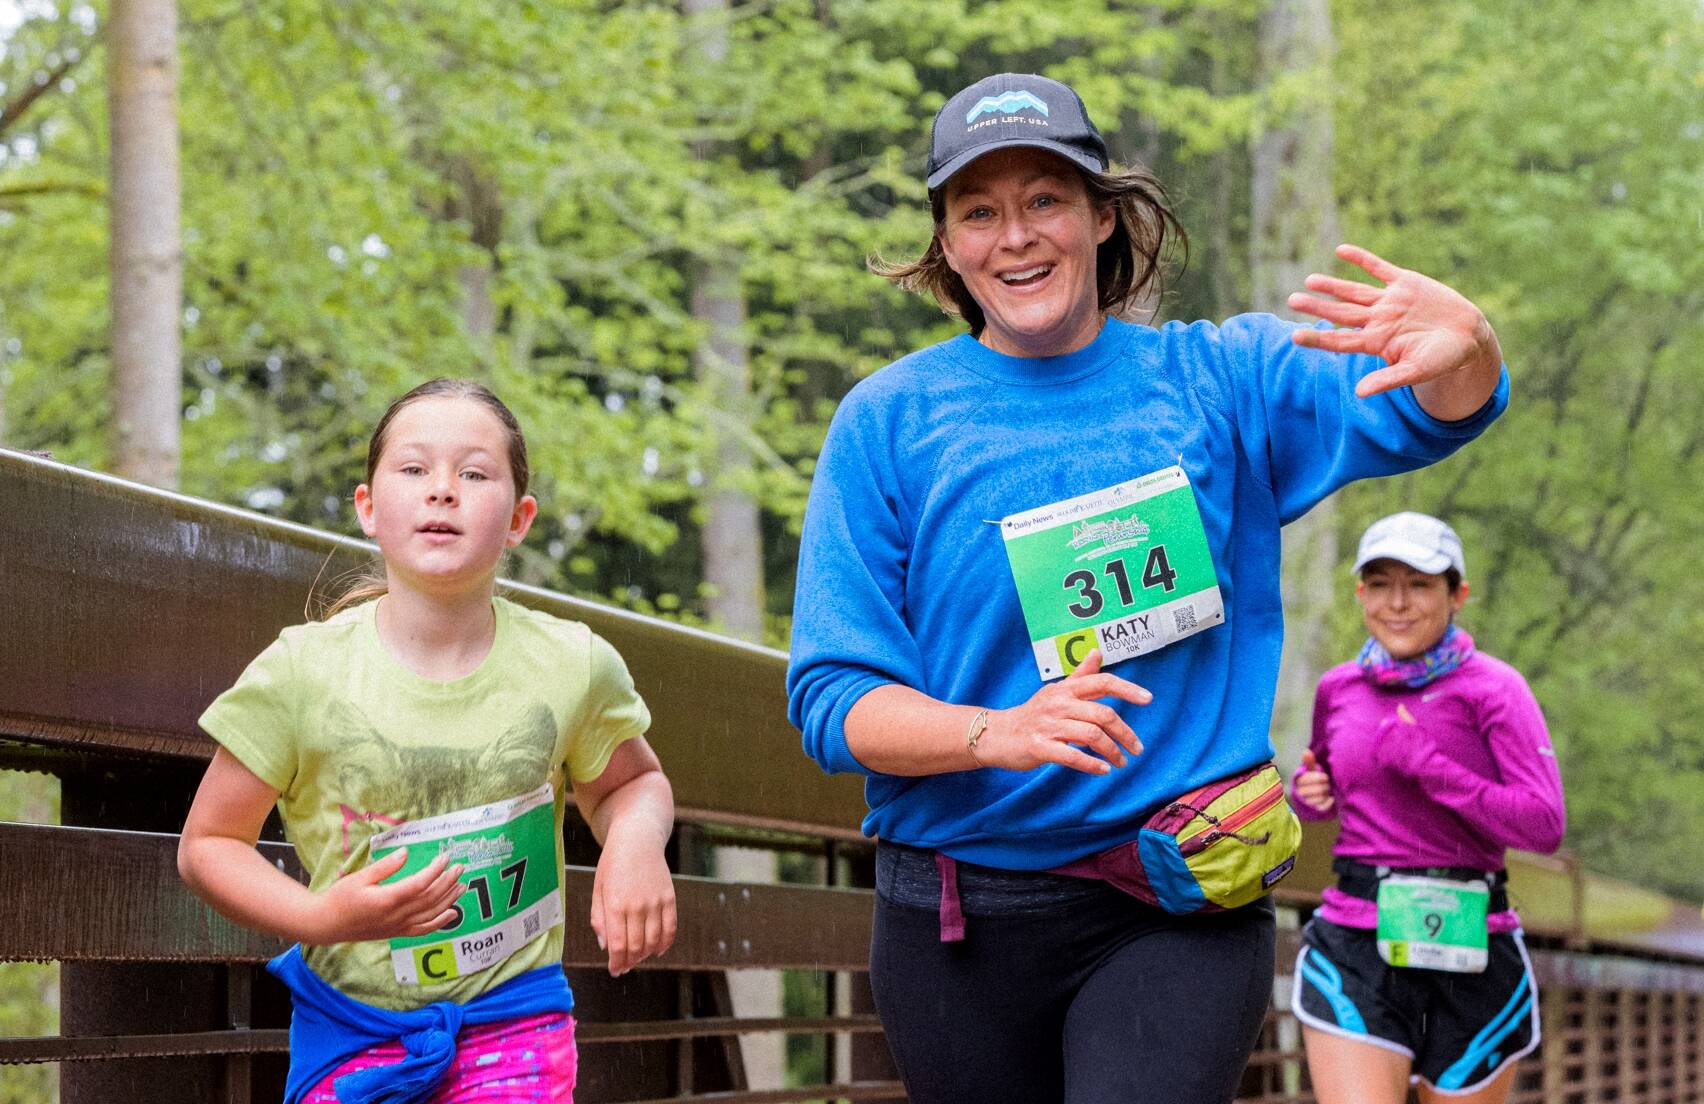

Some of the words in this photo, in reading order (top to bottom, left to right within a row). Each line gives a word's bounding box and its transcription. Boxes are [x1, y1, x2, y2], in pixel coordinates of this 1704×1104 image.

[967, 118, 997, 132] UPPER
[1028, 118, 1049, 127] USA
[1013, 518, 1032, 530] Daily
[1033, 514, 1054, 525] News
[1063, 544, 1178, 620] 314
[1100, 614, 1150, 643] KATY
[1105, 629, 1155, 652] BOWMAN
[1064, 635, 1086, 668] C
[1126, 643, 1140, 654] 10K
[1424, 912, 1443, 938] 9
[461, 931, 504, 956] Roan
[422, 949, 448, 979] C
